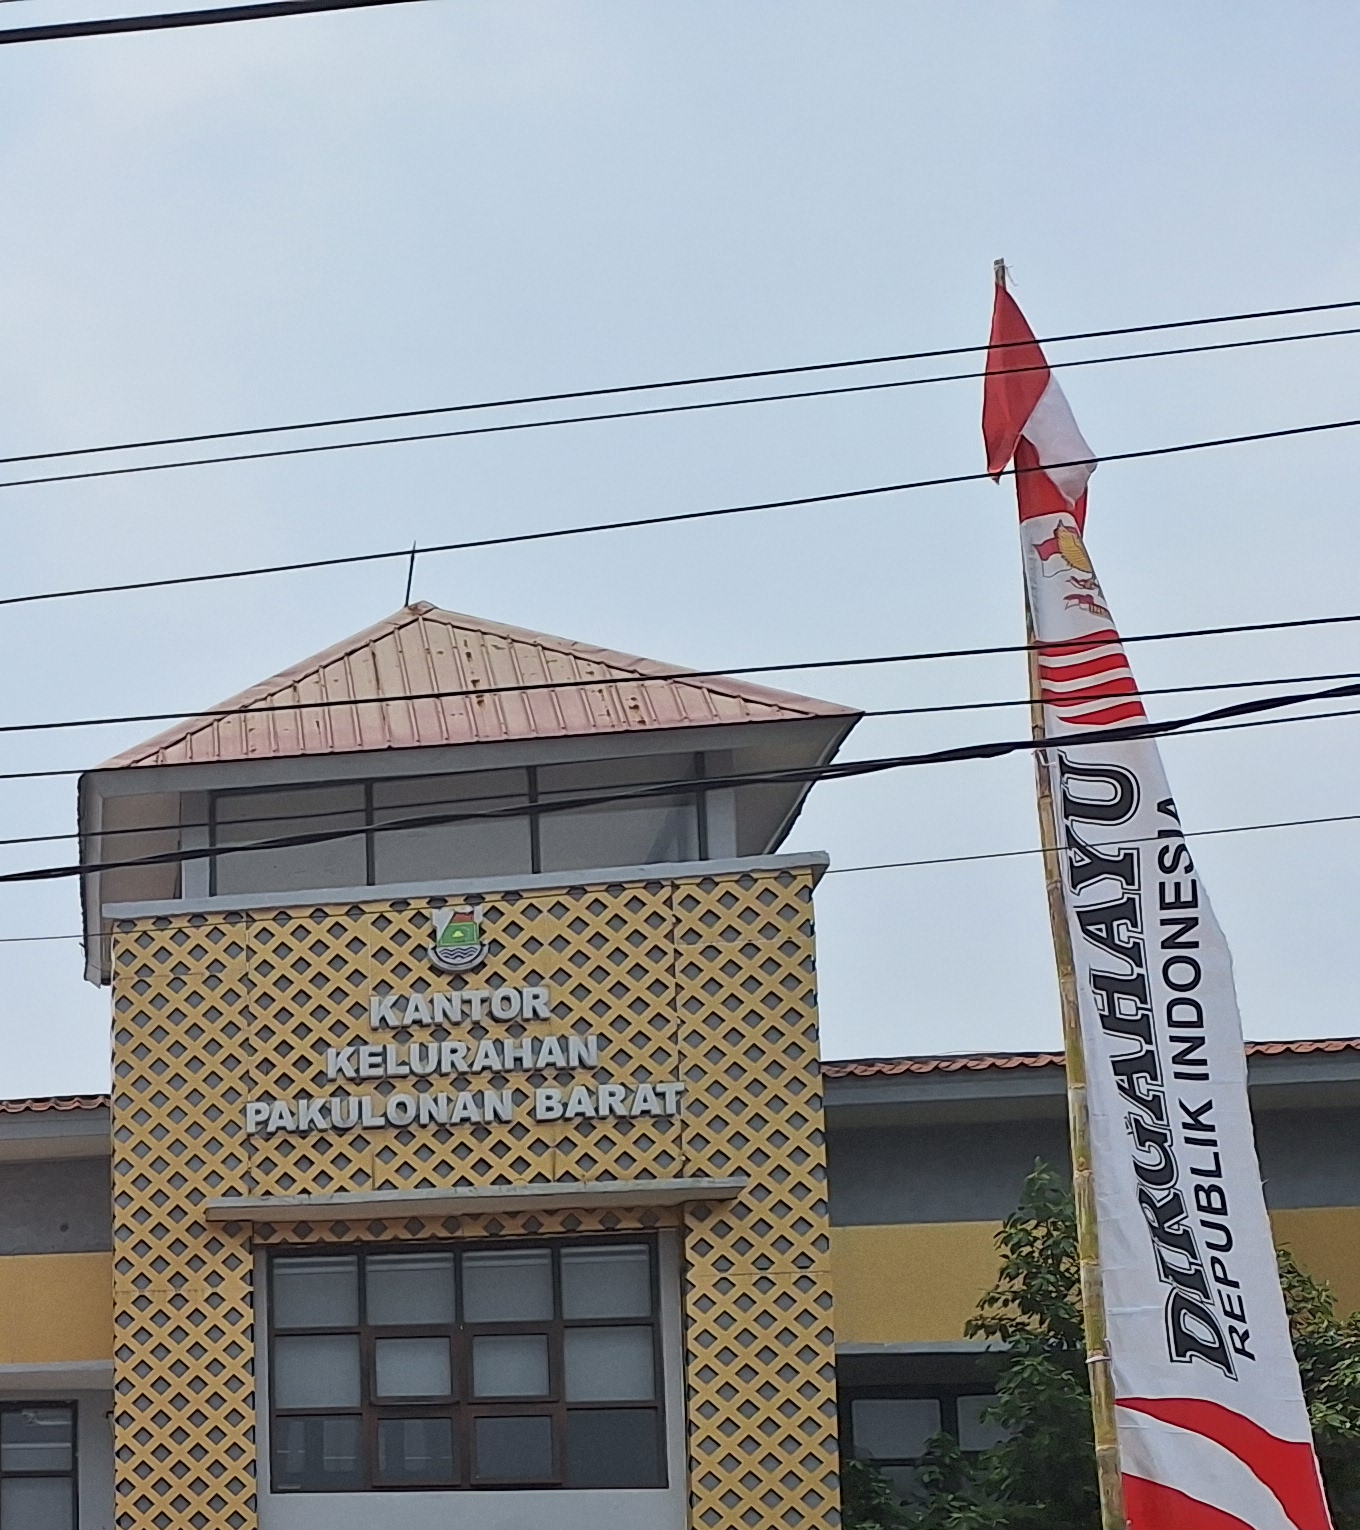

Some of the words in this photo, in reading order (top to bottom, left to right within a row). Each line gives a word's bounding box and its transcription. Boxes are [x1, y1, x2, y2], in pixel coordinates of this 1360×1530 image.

[369, 986, 551, 1031] KANTOR
[1157, 797, 1210, 1081] INDONESIA
[246, 1088, 514, 1138] PAKULONAN
[534, 1081, 685, 1122] BARAT
[326, 1035, 599, 1082] KELURAHAN
[1057, 751, 1237, 1381] DIRGAHAYU
[1178, 1097, 1257, 1361] REPUBLIK
